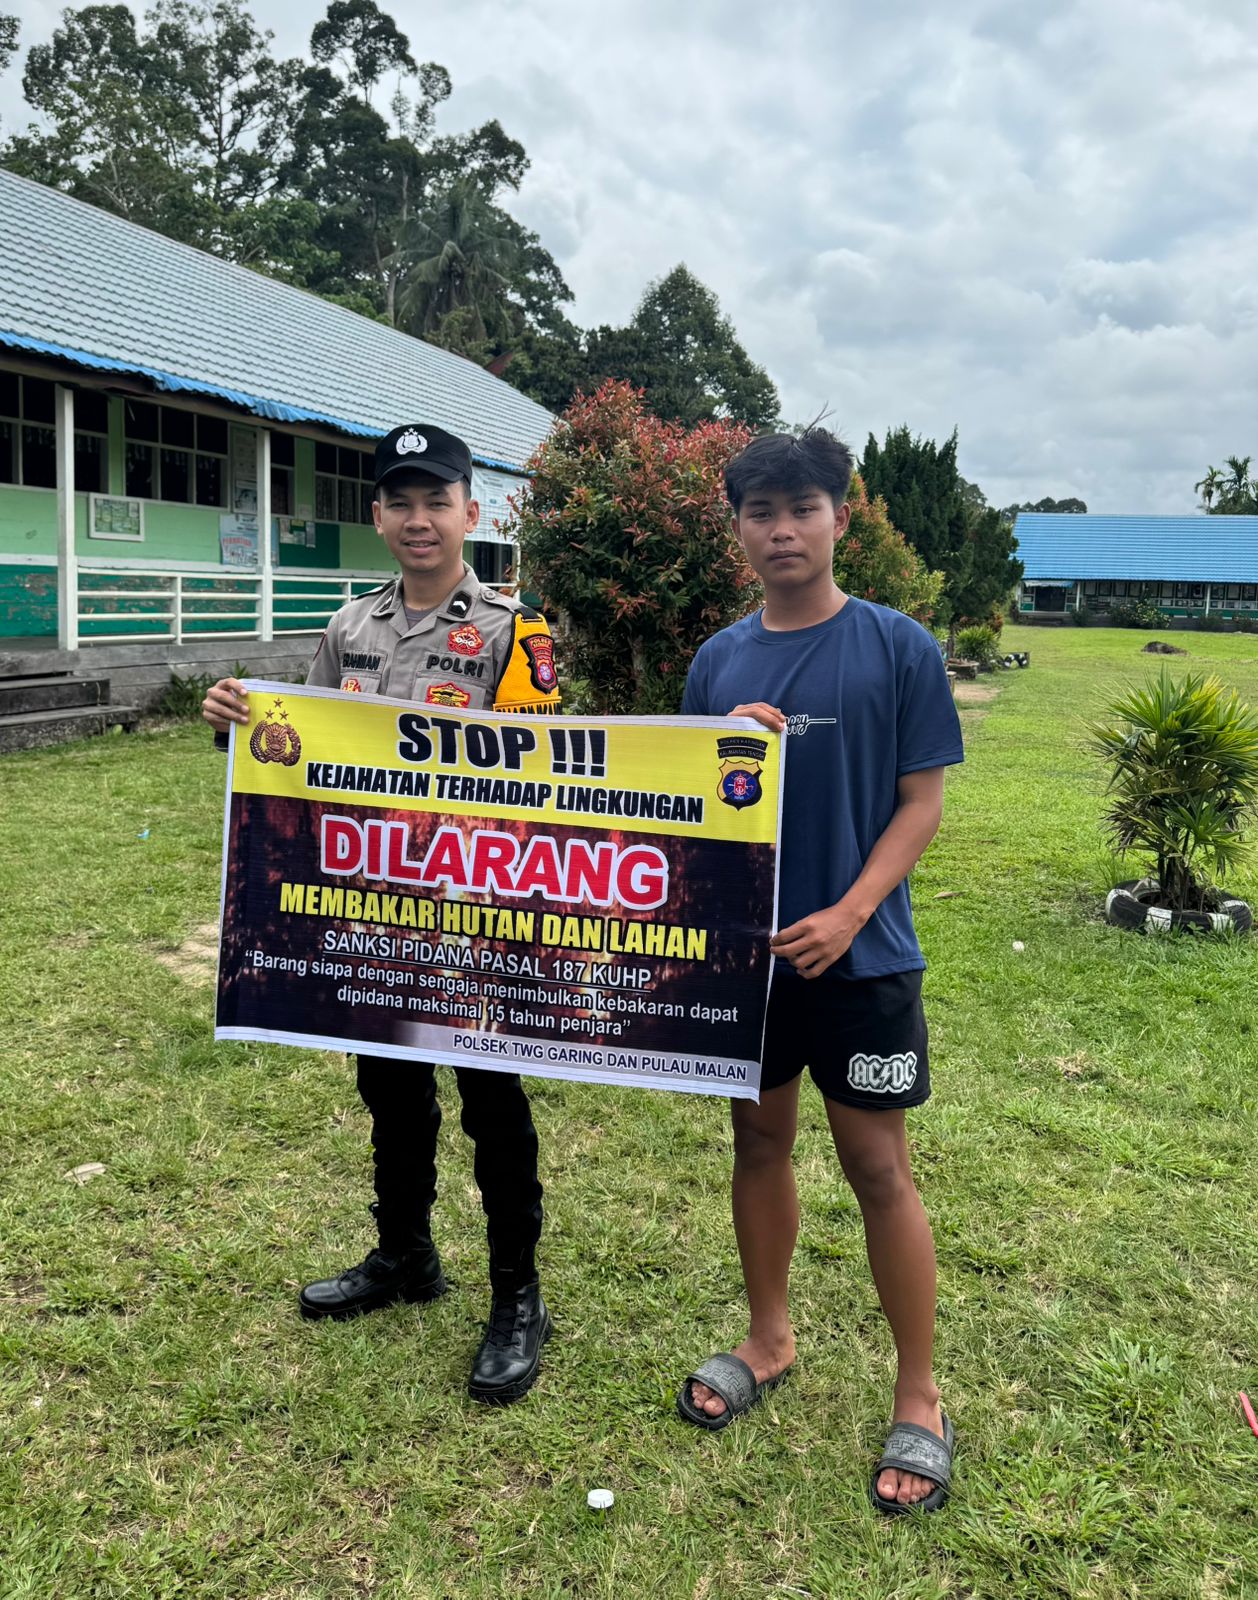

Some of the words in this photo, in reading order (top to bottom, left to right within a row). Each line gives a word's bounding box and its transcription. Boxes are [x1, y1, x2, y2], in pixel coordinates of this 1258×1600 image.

[426, 654, 484, 677] POLRI
[398, 713, 536, 770] STOP
[549, 728, 606, 777] !!!
[307, 762, 431, 797] KEJAHATAN
[435, 774, 552, 808] TERHADAP
[555, 785, 704, 823] LINGKUNGAN
[322, 815, 668, 909] DILARANG
[279, 882, 436, 929] MEMBAKAR
[442, 903, 535, 943] HUTAN
[541, 914, 602, 950] DAN
[609, 921, 707, 961] LAHAN
[245, 950, 307, 976] “Barang
[311, 958, 353, 980] siapa
[357, 963, 414, 987] dengan
[419, 974, 479, 996] sengaja
[484, 983, 592, 1009] menimbulkan
[597, 992, 685, 1018] kebakaran
[690, 1002, 738, 1024] dapat
[323, 930, 396, 958] SANKSI
[402, 940, 475, 968] PIDANA
[481, 951, 546, 978] PASAL
[552, 960, 586, 982] 187
[592, 964, 651, 989] KUHP
[337, 985, 403, 1009] dipidana
[408, 996, 482, 1020] maksimal
[487, 1004, 505, 1022] 15
[510, 1007, 555, 1029] tahun
[560, 1017, 631, 1037] penjara”
[453, 1033, 508, 1054] POLSEK
[512, 1042, 544, 1059] TWG
[549, 1047, 602, 1065] GARING
[607, 1053, 638, 1070] DAN
[642, 1056, 690, 1075] PULAU
[695, 1062, 747, 1081] MALAN
